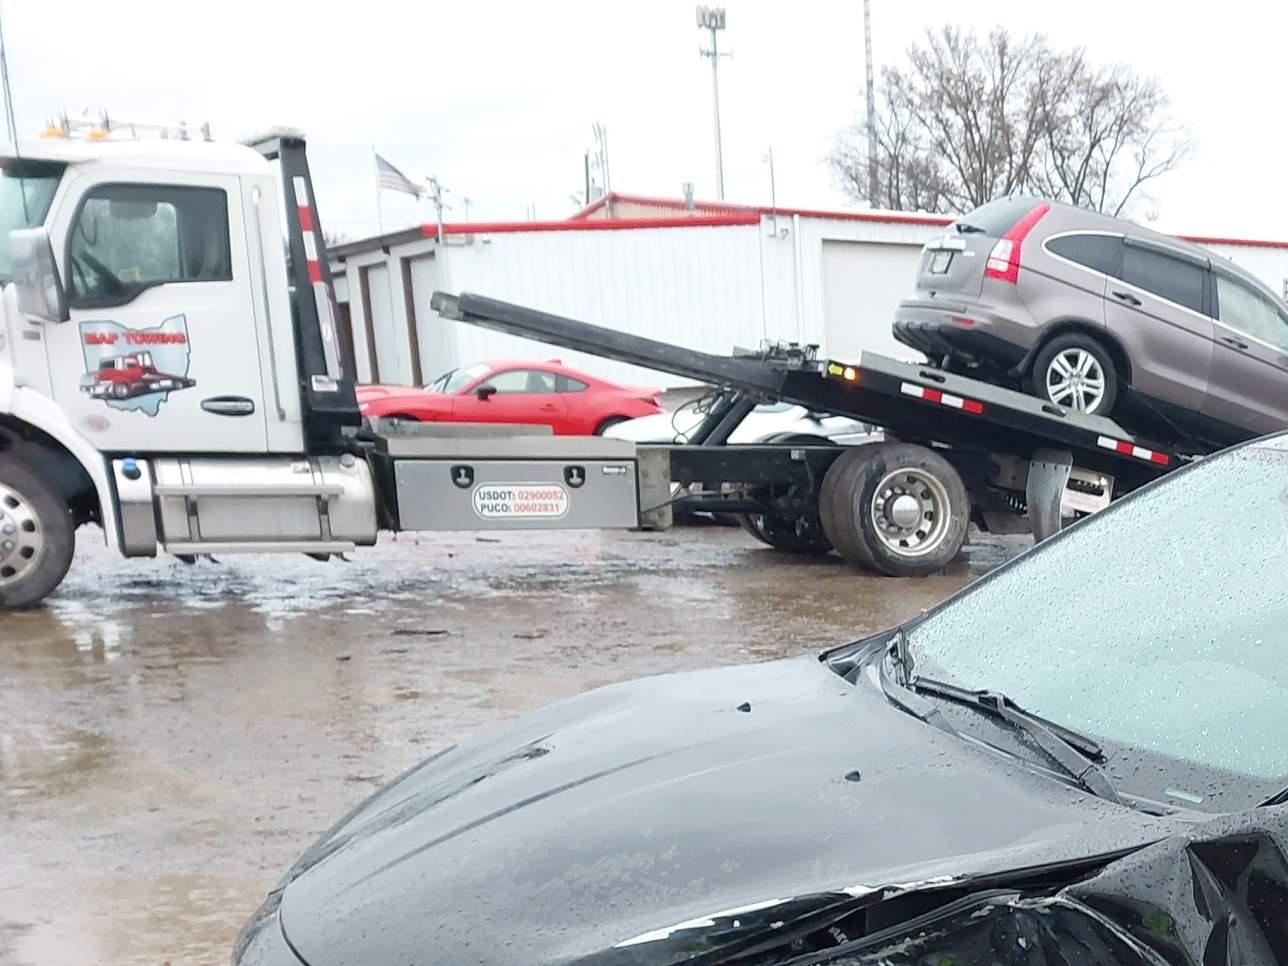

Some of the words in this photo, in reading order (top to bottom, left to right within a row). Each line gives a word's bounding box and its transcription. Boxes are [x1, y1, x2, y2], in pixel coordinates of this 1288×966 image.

[122, 332, 186, 345] TOWING
[478, 490, 516, 500] USDOT:
[480, 503, 512, 513] PUCO:
